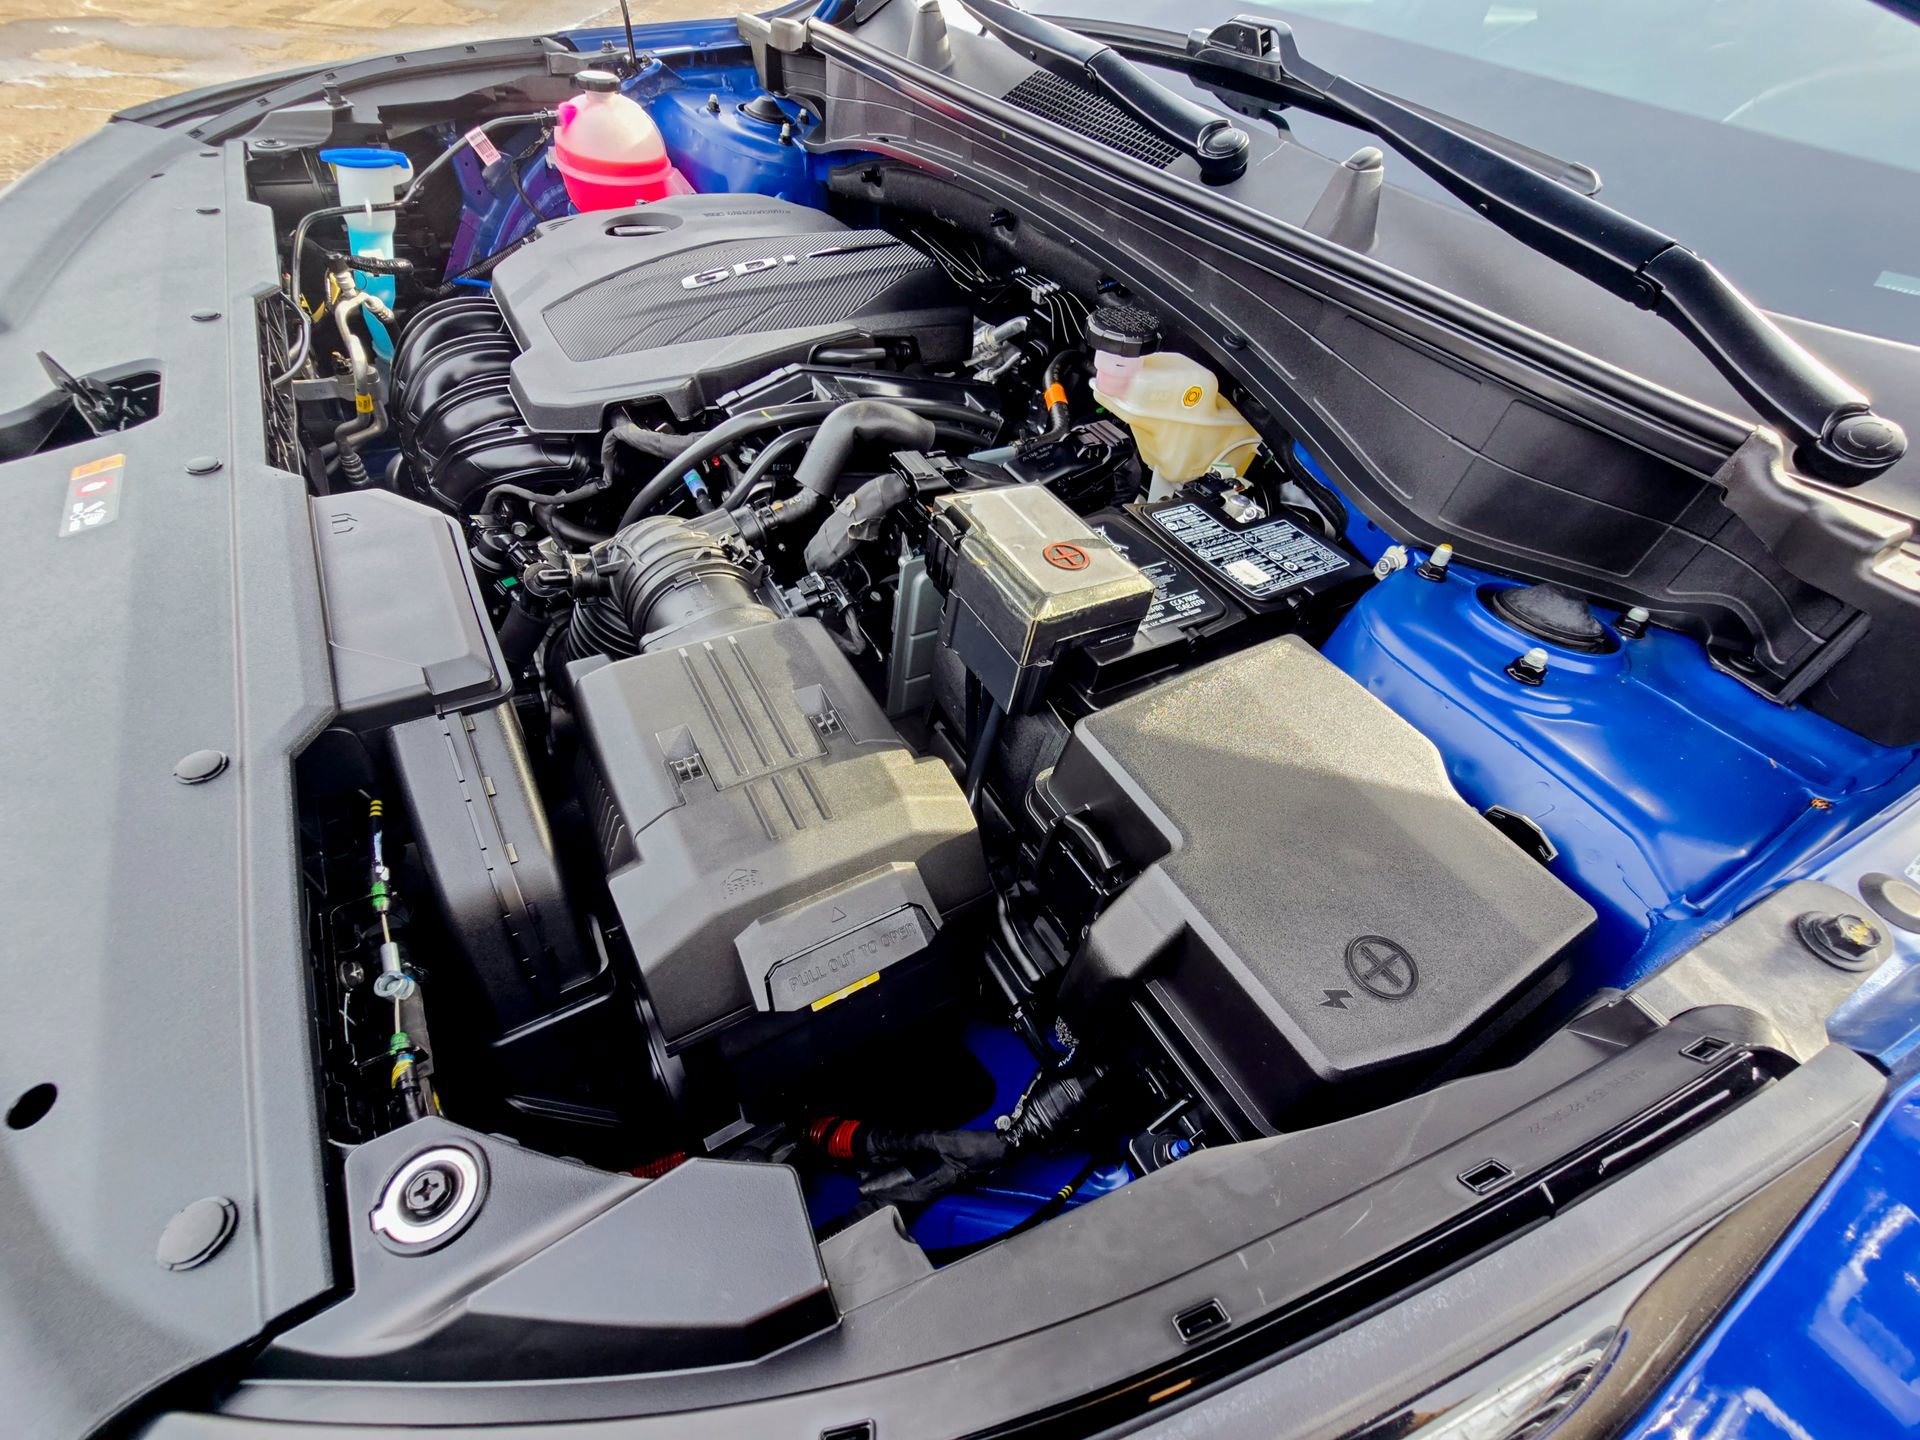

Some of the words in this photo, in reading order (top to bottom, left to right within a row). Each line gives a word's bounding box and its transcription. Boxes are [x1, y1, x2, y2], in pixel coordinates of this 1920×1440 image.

[788, 966, 827, 992] PULL
[828, 948, 856, 972] OUT
[858, 940, 879, 956] TO
[881, 922, 917, 947] OPEN
